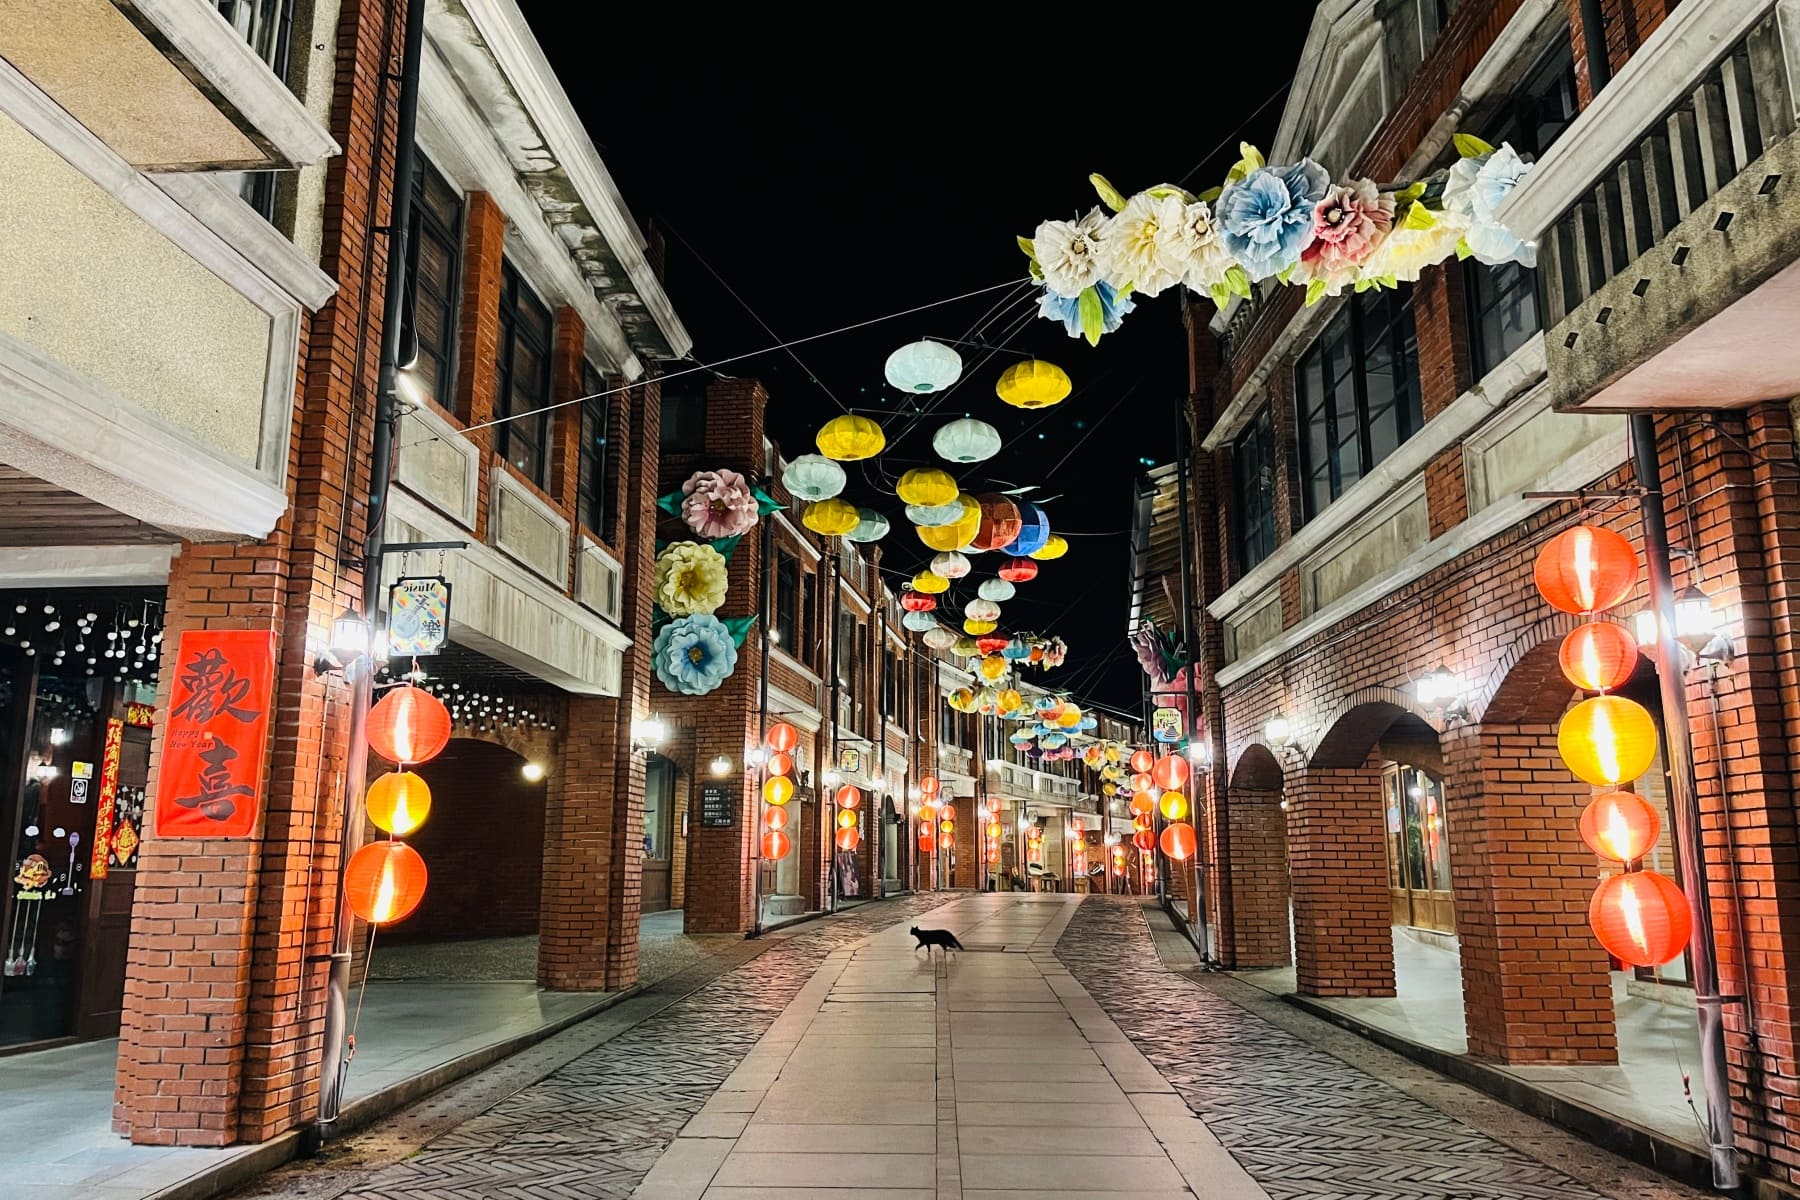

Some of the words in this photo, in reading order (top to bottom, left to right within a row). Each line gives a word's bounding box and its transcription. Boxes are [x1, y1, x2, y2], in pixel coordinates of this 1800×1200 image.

[171, 728, 200, 738] Happy
[171, 648, 262, 821] 歡喜
[169, 740, 187, 748] New
[191, 740, 213, 748] Year
